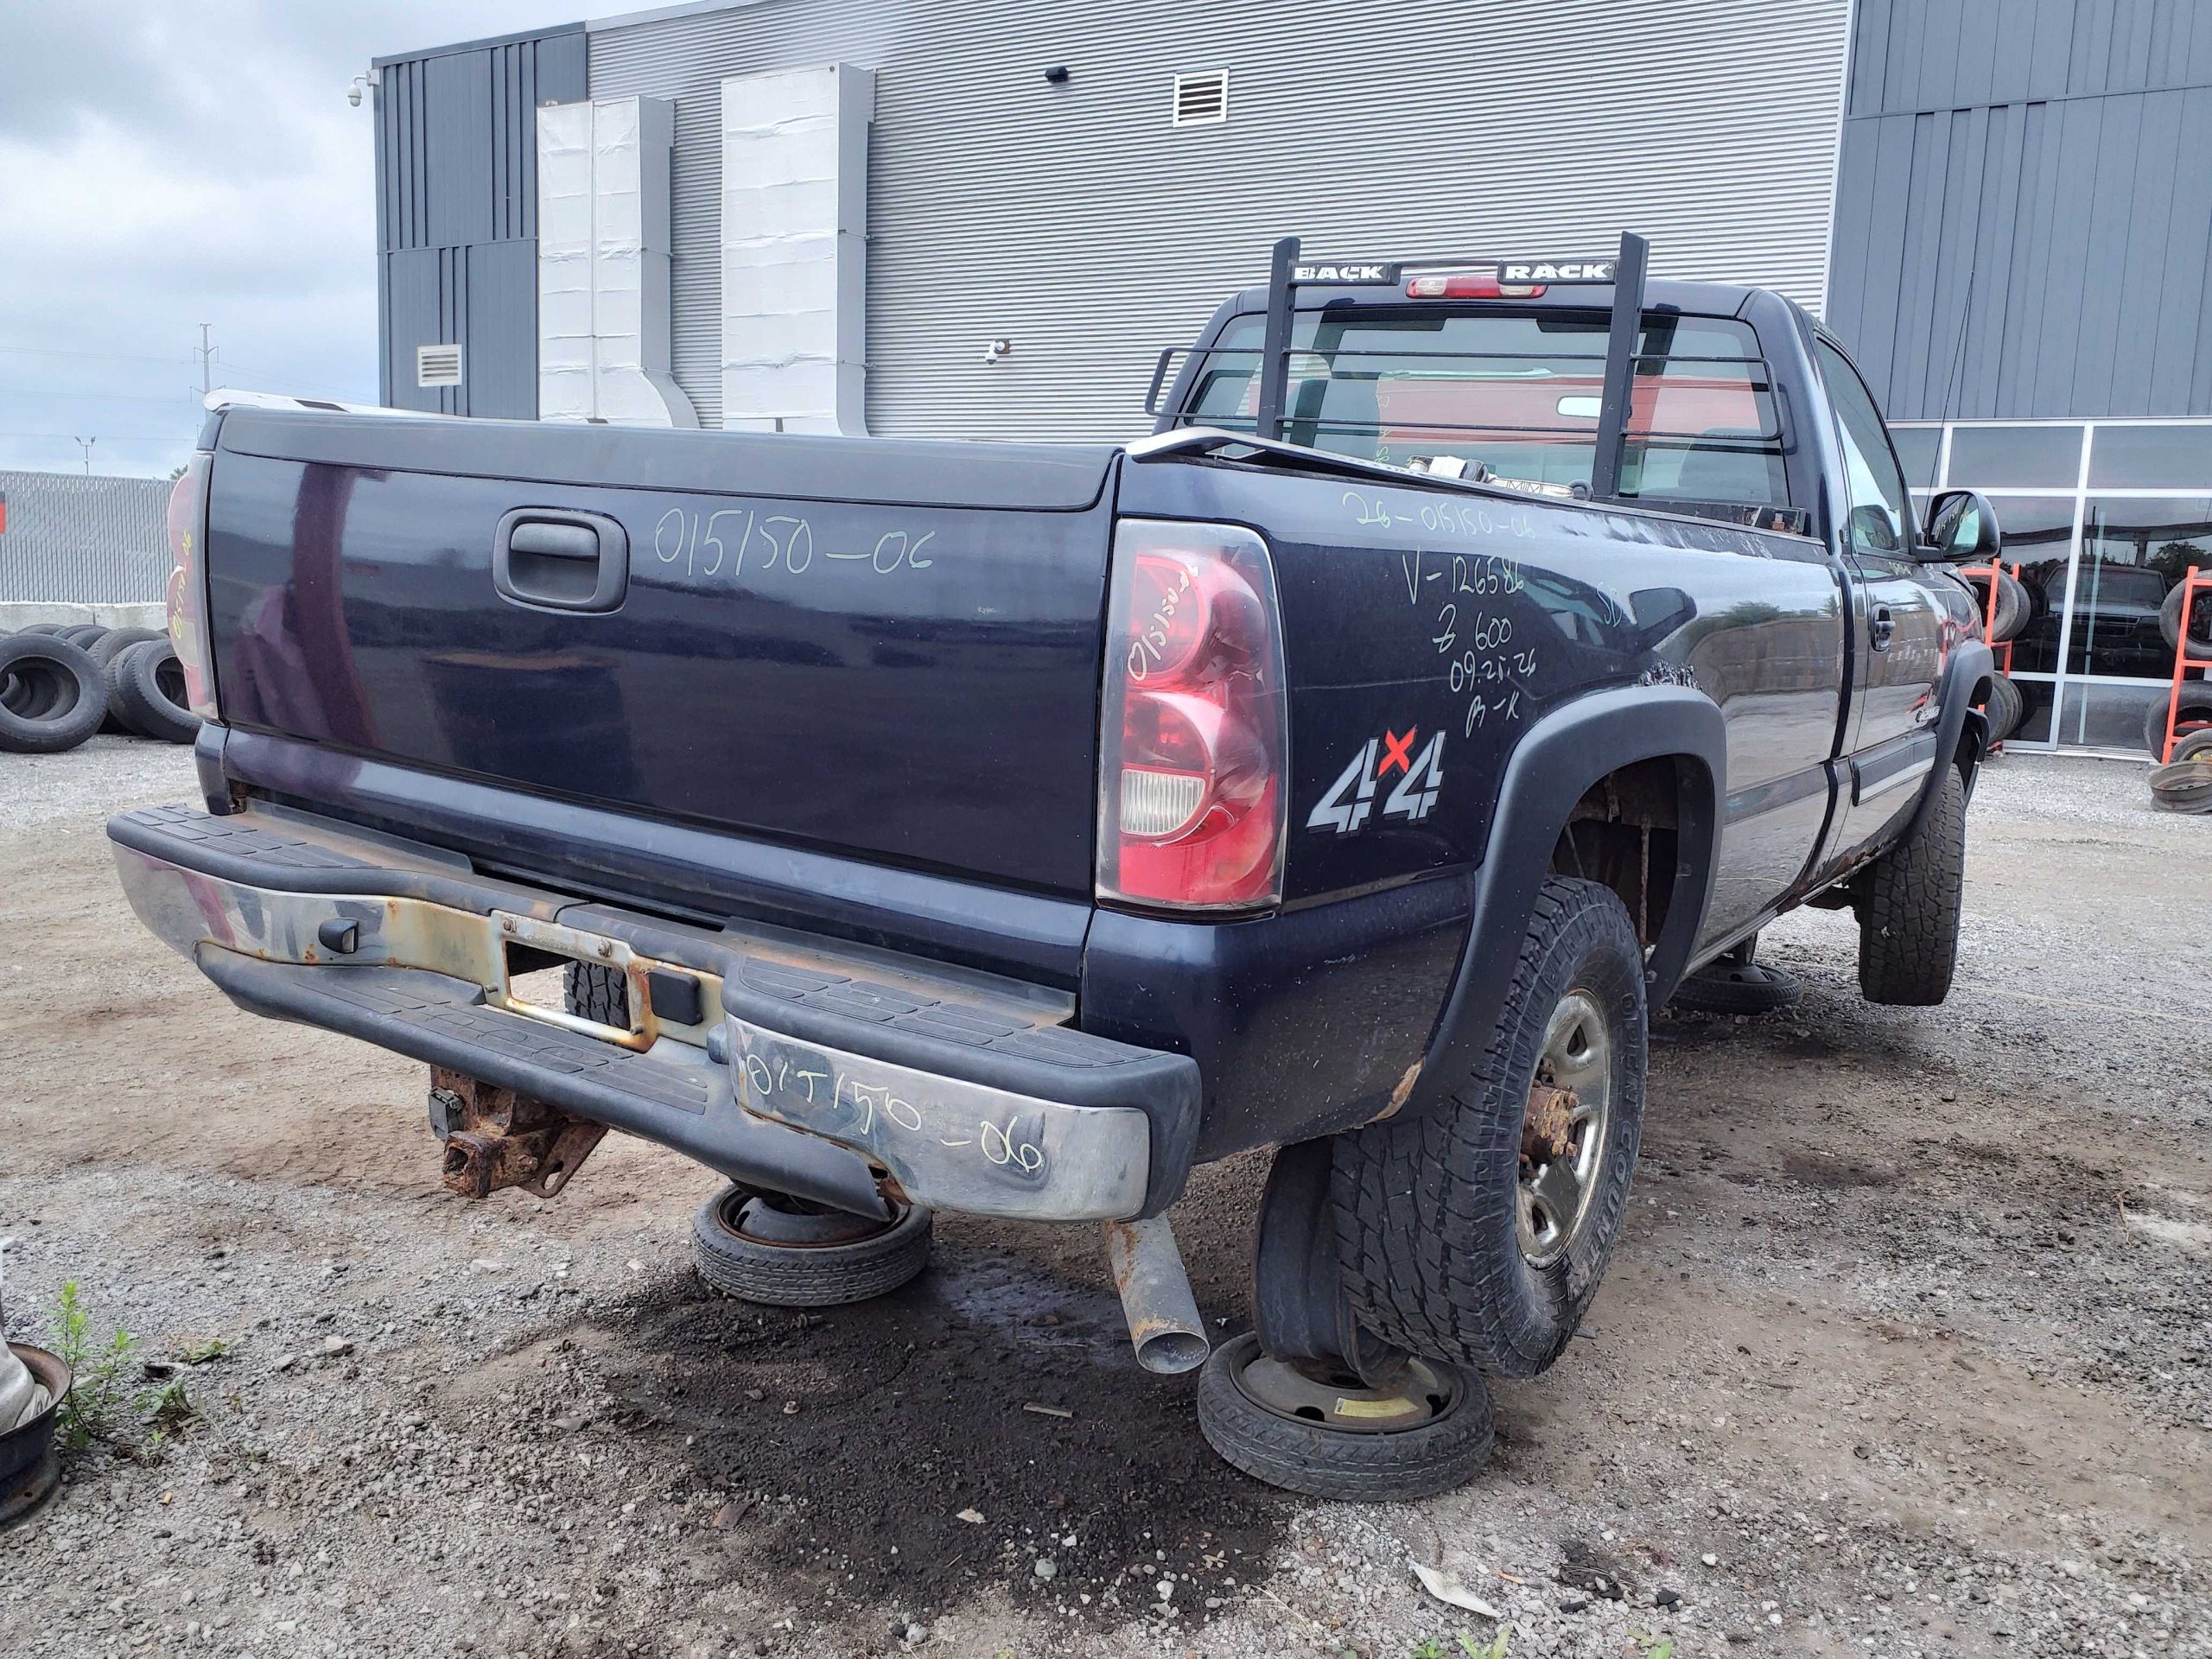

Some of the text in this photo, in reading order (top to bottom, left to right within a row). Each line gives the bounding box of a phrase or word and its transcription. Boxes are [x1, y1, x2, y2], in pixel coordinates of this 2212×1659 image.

[1294, 264, 1610, 282] BACK RACK
[655, 507, 937, 576] 015150-06
[1475, 610, 1513, 652] 600
